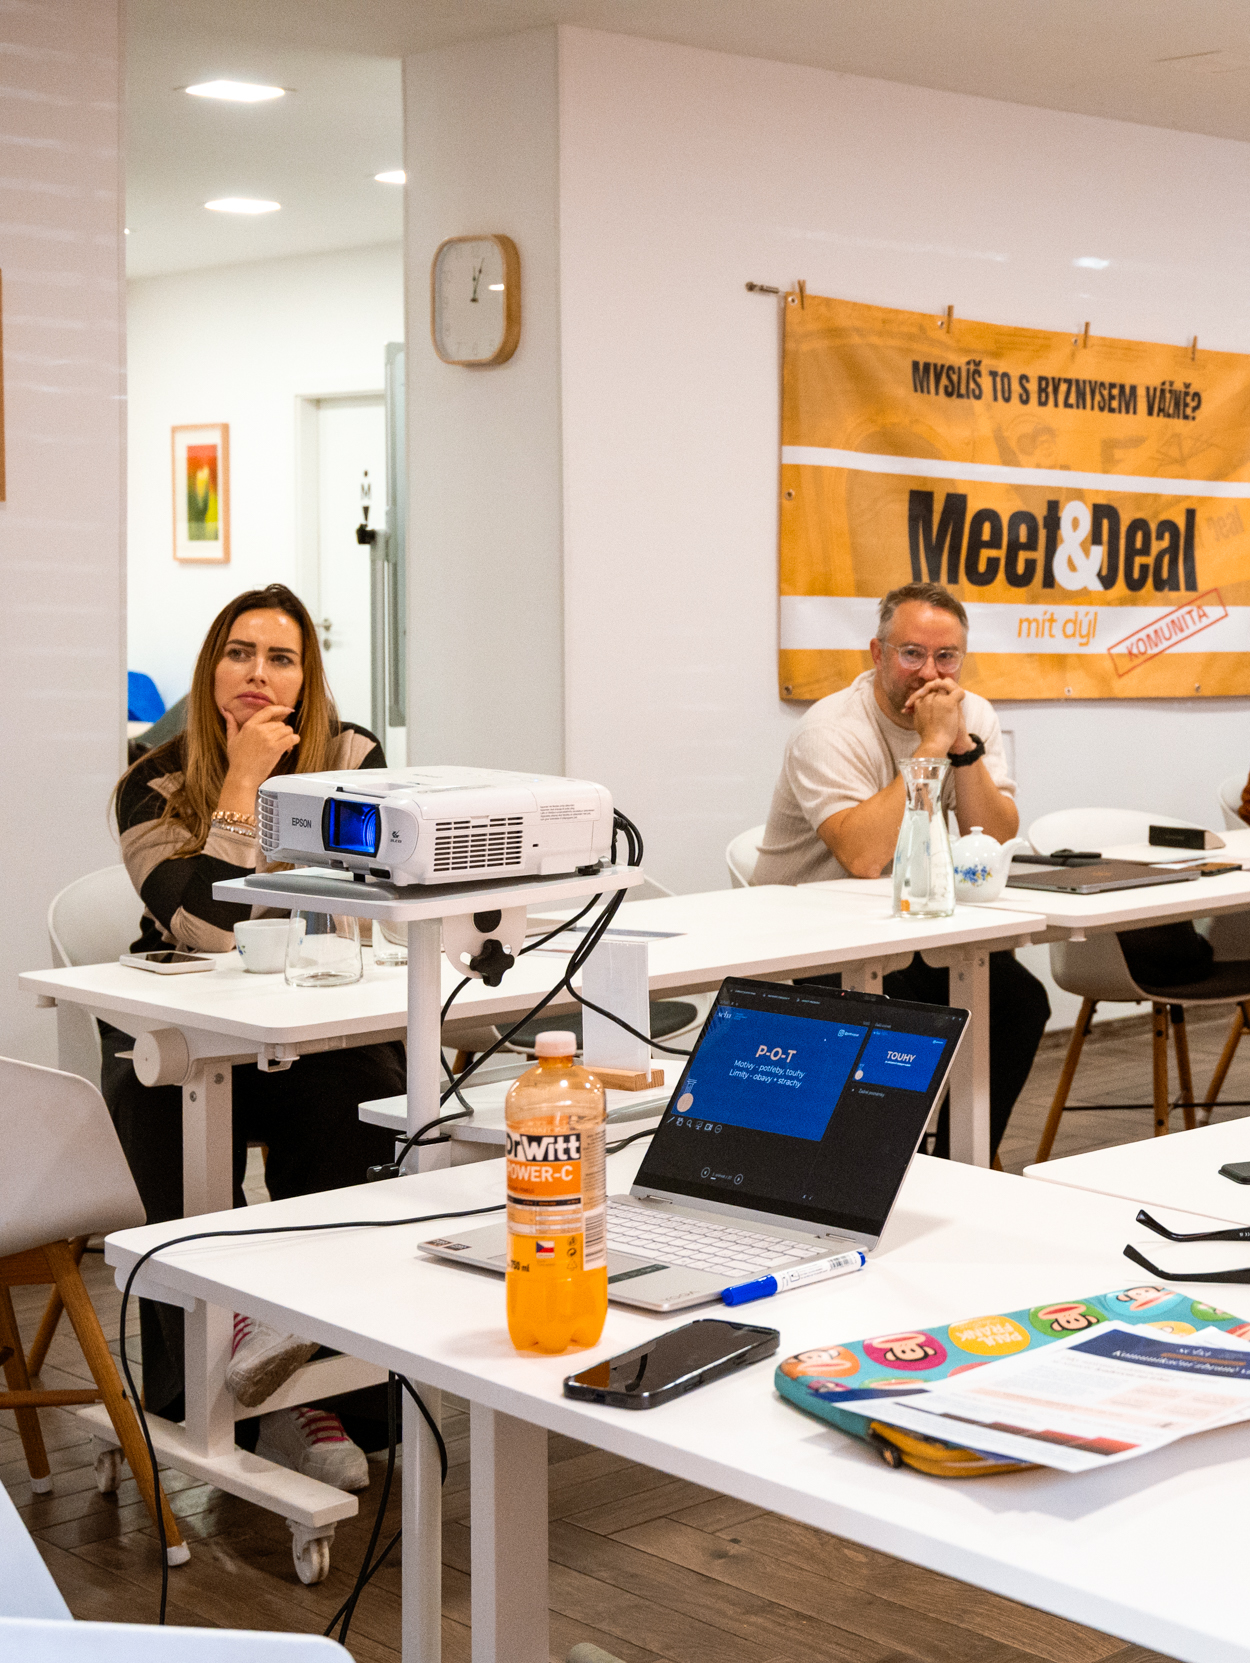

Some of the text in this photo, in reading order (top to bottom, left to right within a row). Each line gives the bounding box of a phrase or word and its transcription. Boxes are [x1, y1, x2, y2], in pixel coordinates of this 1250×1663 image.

[912, 358, 1203, 422] MYSLÍŠ TO S BYZNYSEM VÁŽNĚ?
[1017, 610, 1099, 648] mít dýl
[1125, 605, 1210, 663] KOMUNITA
[291, 817, 312, 829] EPSON
[755, 1045, 798, 1063] P-O-T
[886, 1050, 917, 1063] TOUHY
[728, 1069, 750, 1080] Limity
[752, 1072, 774, 1084] obavy
[777, 1077, 803, 1089] strachy
[733, 1059, 756, 1071] Motivy
[785, 1068, 806, 1079] touhy
[521, 1263, 531, 1273] ml
[955, 1322, 1014, 1343] FRANK
[977, 1331, 1023, 1347] PAUL
